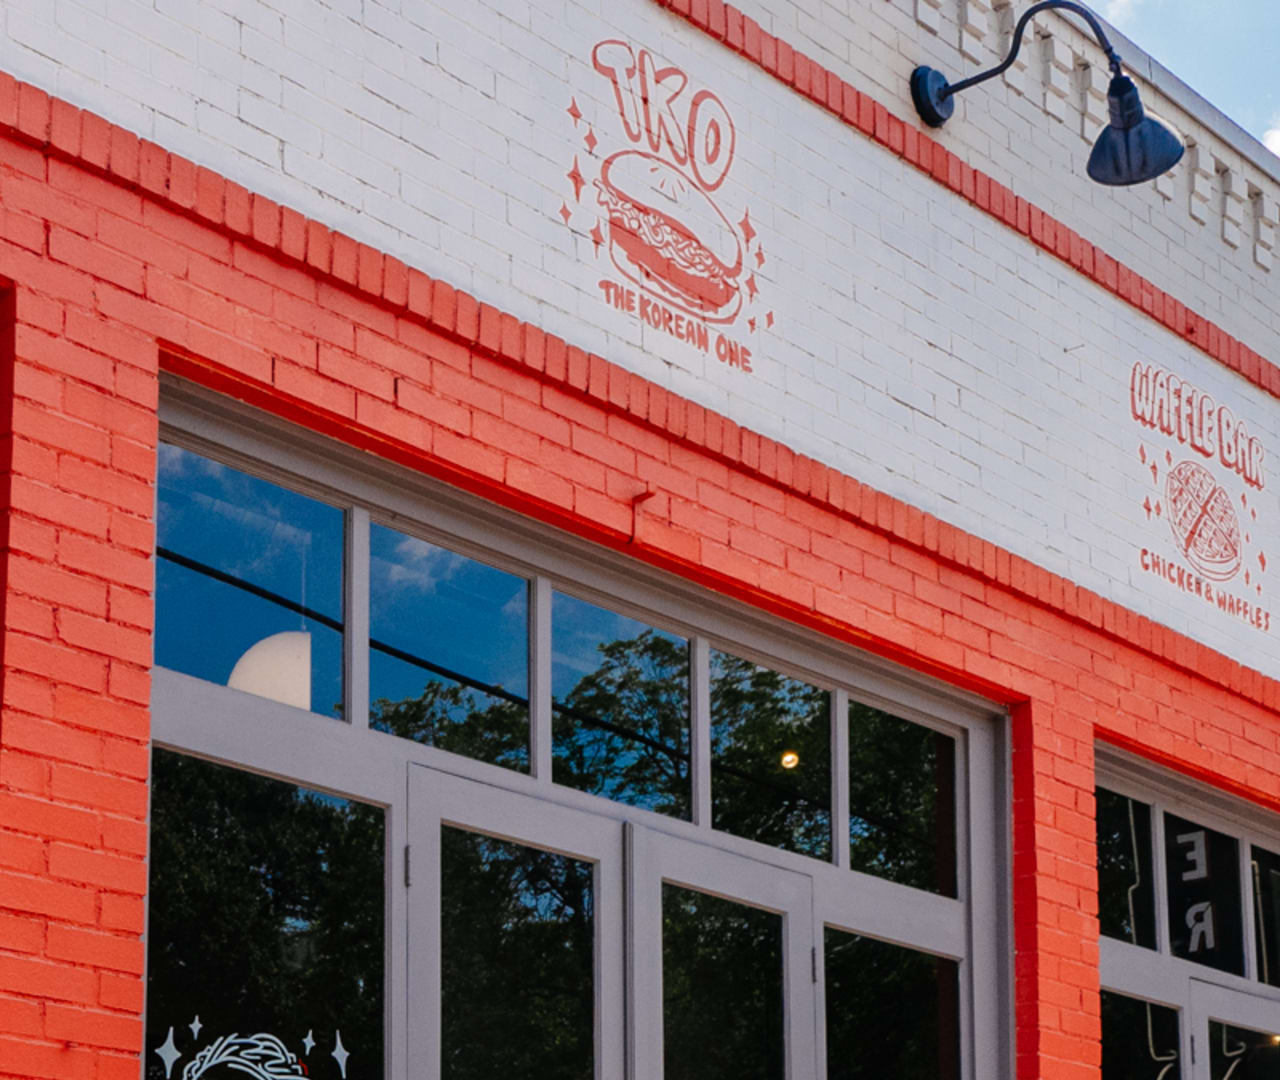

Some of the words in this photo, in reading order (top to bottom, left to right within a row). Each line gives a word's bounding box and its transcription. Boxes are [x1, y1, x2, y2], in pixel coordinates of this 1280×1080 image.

[592, 40, 735, 191] TKO
[598, 280, 636, 312] THE
[639, 298, 710, 352] KOREAN
[716, 334, 754, 373] ONE
[1130, 361, 1215, 458] WAFFLE
[1218, 405, 1265, 491] BAR
[1140, 549, 1202, 598] CHICKEN
[1205, 584, 1214, 603] &
[1217, 591, 1270, 631] WAFFLES
